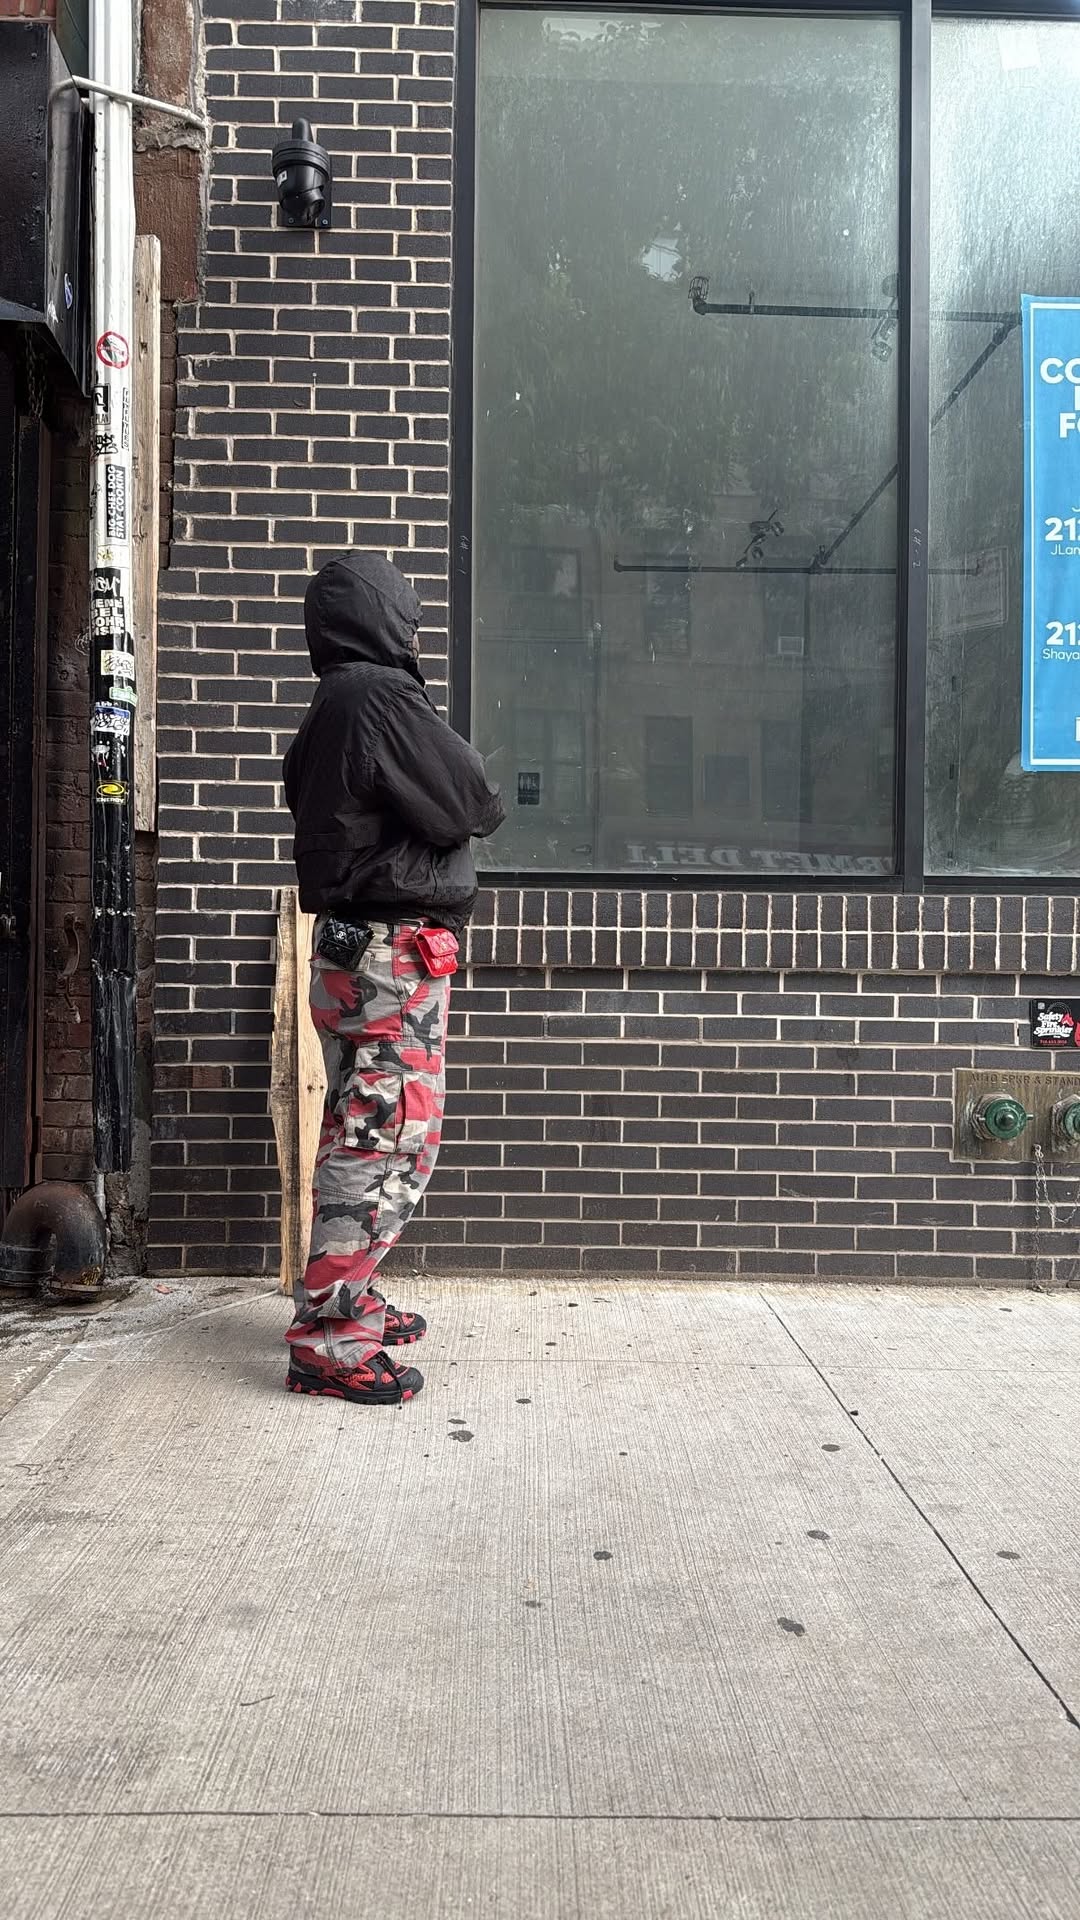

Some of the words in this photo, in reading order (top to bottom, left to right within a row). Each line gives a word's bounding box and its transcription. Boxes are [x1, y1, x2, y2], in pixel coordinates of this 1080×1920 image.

[1060, 413, 1080, 438] F
[107, 465, 116, 489] DOG
[116, 469, 125, 512] COOKIN
[116, 513, 125, 539] STAY
[1045, 517, 1080, 541] 21
[1045, 621, 1080, 646] 21
[1037, 1012, 1064, 1023] Safety
[1041, 1020, 1058, 1029] Fire
